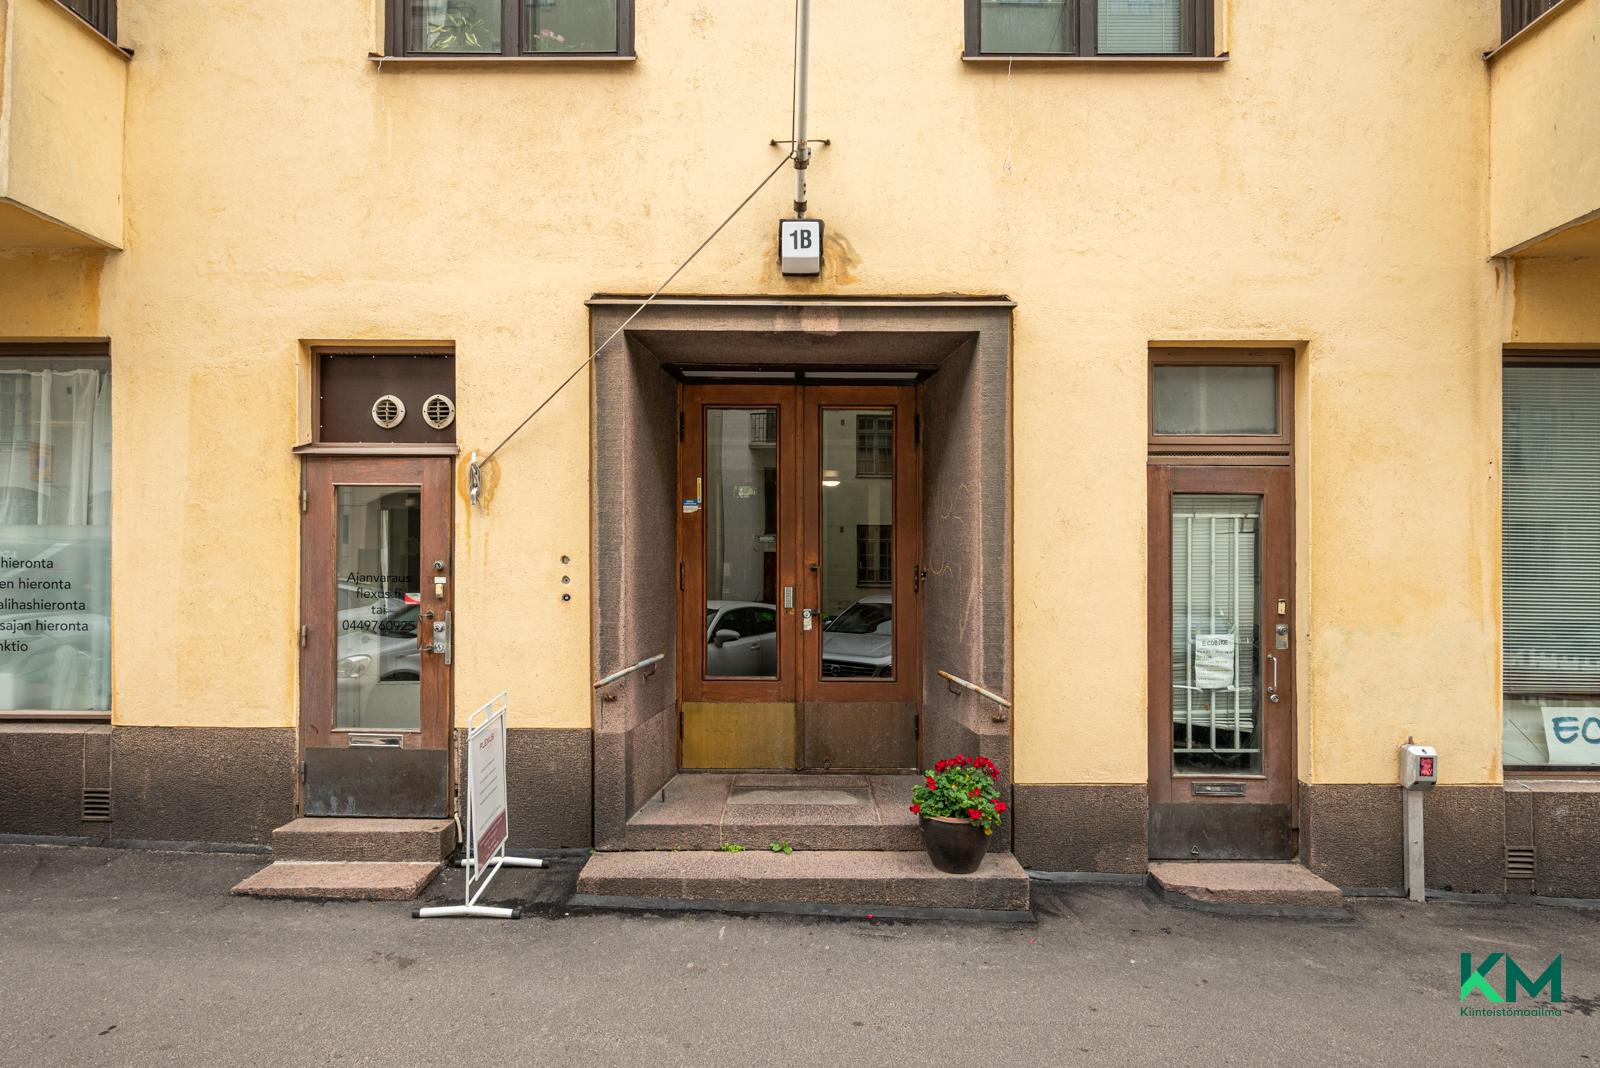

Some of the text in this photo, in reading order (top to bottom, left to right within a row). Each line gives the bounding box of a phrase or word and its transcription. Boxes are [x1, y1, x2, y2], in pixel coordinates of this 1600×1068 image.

[789, 229, 812, 250] 1B
[1, 557, 54, 569] hieronta
[18, 577, 71, 590] hieronta
[346, 571, 411, 586] Ajanvaraus
[356, 587, 401, 599] flexus.fi
[371, 605, 386, 615] tai
[0, 619, 89, 634] sajan hieronta
